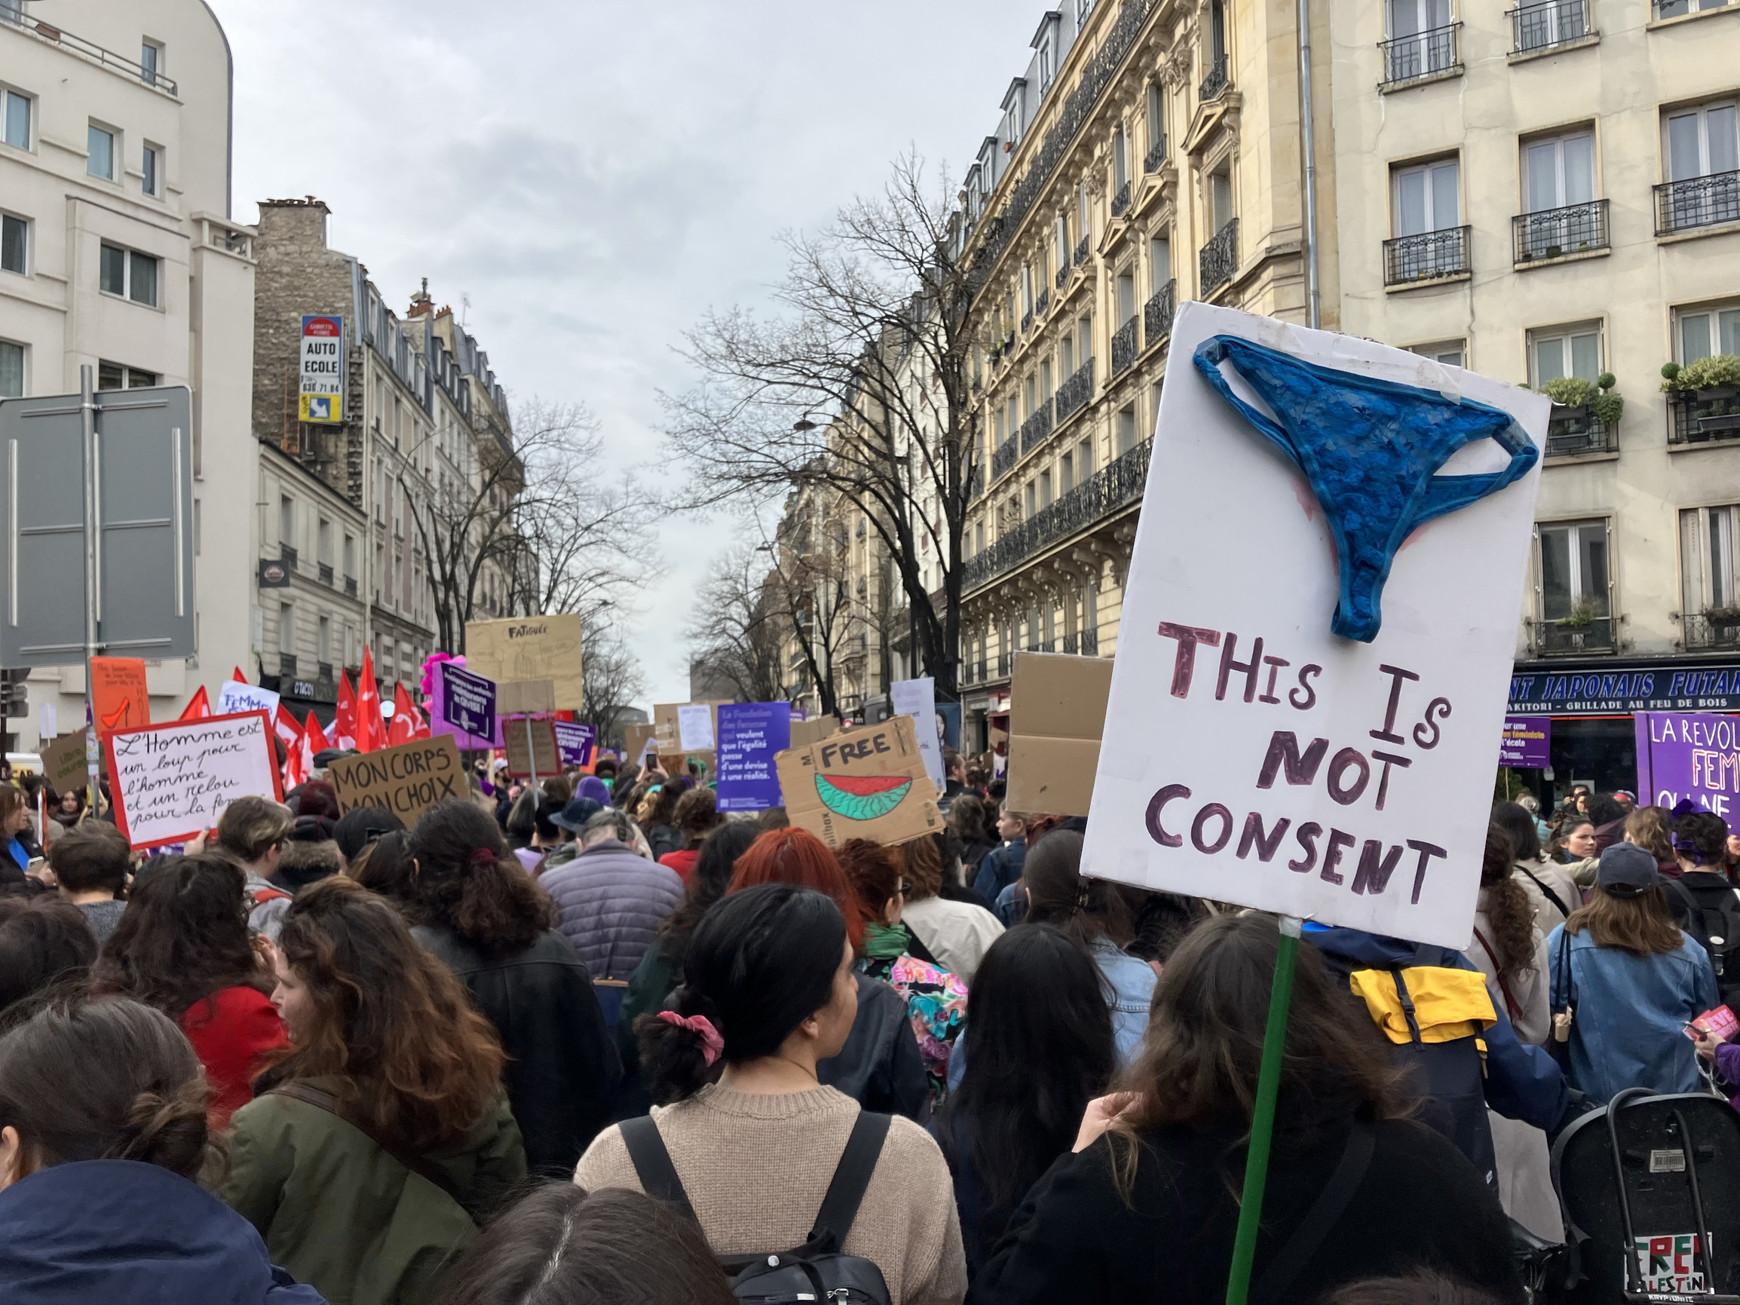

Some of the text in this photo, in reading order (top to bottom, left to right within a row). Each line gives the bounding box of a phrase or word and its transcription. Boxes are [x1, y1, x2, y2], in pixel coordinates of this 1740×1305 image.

[307, 342, 336, 355] AUTO
[304, 360, 338, 373] ECOLE
[1158, 621, 1452, 750] THIS IS
[1542, 672, 1655, 699] JAPONAIS
[225, 694, 273, 715] FEMM
[1506, 702, 1552, 711] AKITORI
[1566, 701, 1622, 710] GRILLADE
[1628, 700, 1644, 708] AU
[1650, 699, 1671, 708] FEU
[1678, 698, 1693, 707] DE
[1699, 698, 1728, 707] BOIS
[116, 717, 263, 756] L'Homme est
[721, 740, 767, 753] que l'égalité
[736, 729, 764, 739] veulent
[1651, 718, 1740, 750] LA REVOL
[119, 742, 246, 776] un loup pour
[721, 753, 743, 762] passe
[721, 760, 768, 771] d'une devise
[821, 733, 891, 769] FREE
[123, 769, 209, 796] l'homme
[333, 748, 451, 793] MON CORPS
[743, 770, 770, 780] réalité.
[1256, 730, 1412, 811] NOT
[1692, 748, 1740, 794] FEM
[126, 775, 241, 813] et un relou
[394, 774, 458, 812] CHOIX
[130, 807, 182, 832] pour
[183, 801, 206, 819] la
[822, 812, 838, 851] ailbox
[1145, 783, 1447, 905] CONSENT
[1706, 1009, 1735, 1031] EVE
[1648, 1294, 1694, 1303] KRYPTONITE
